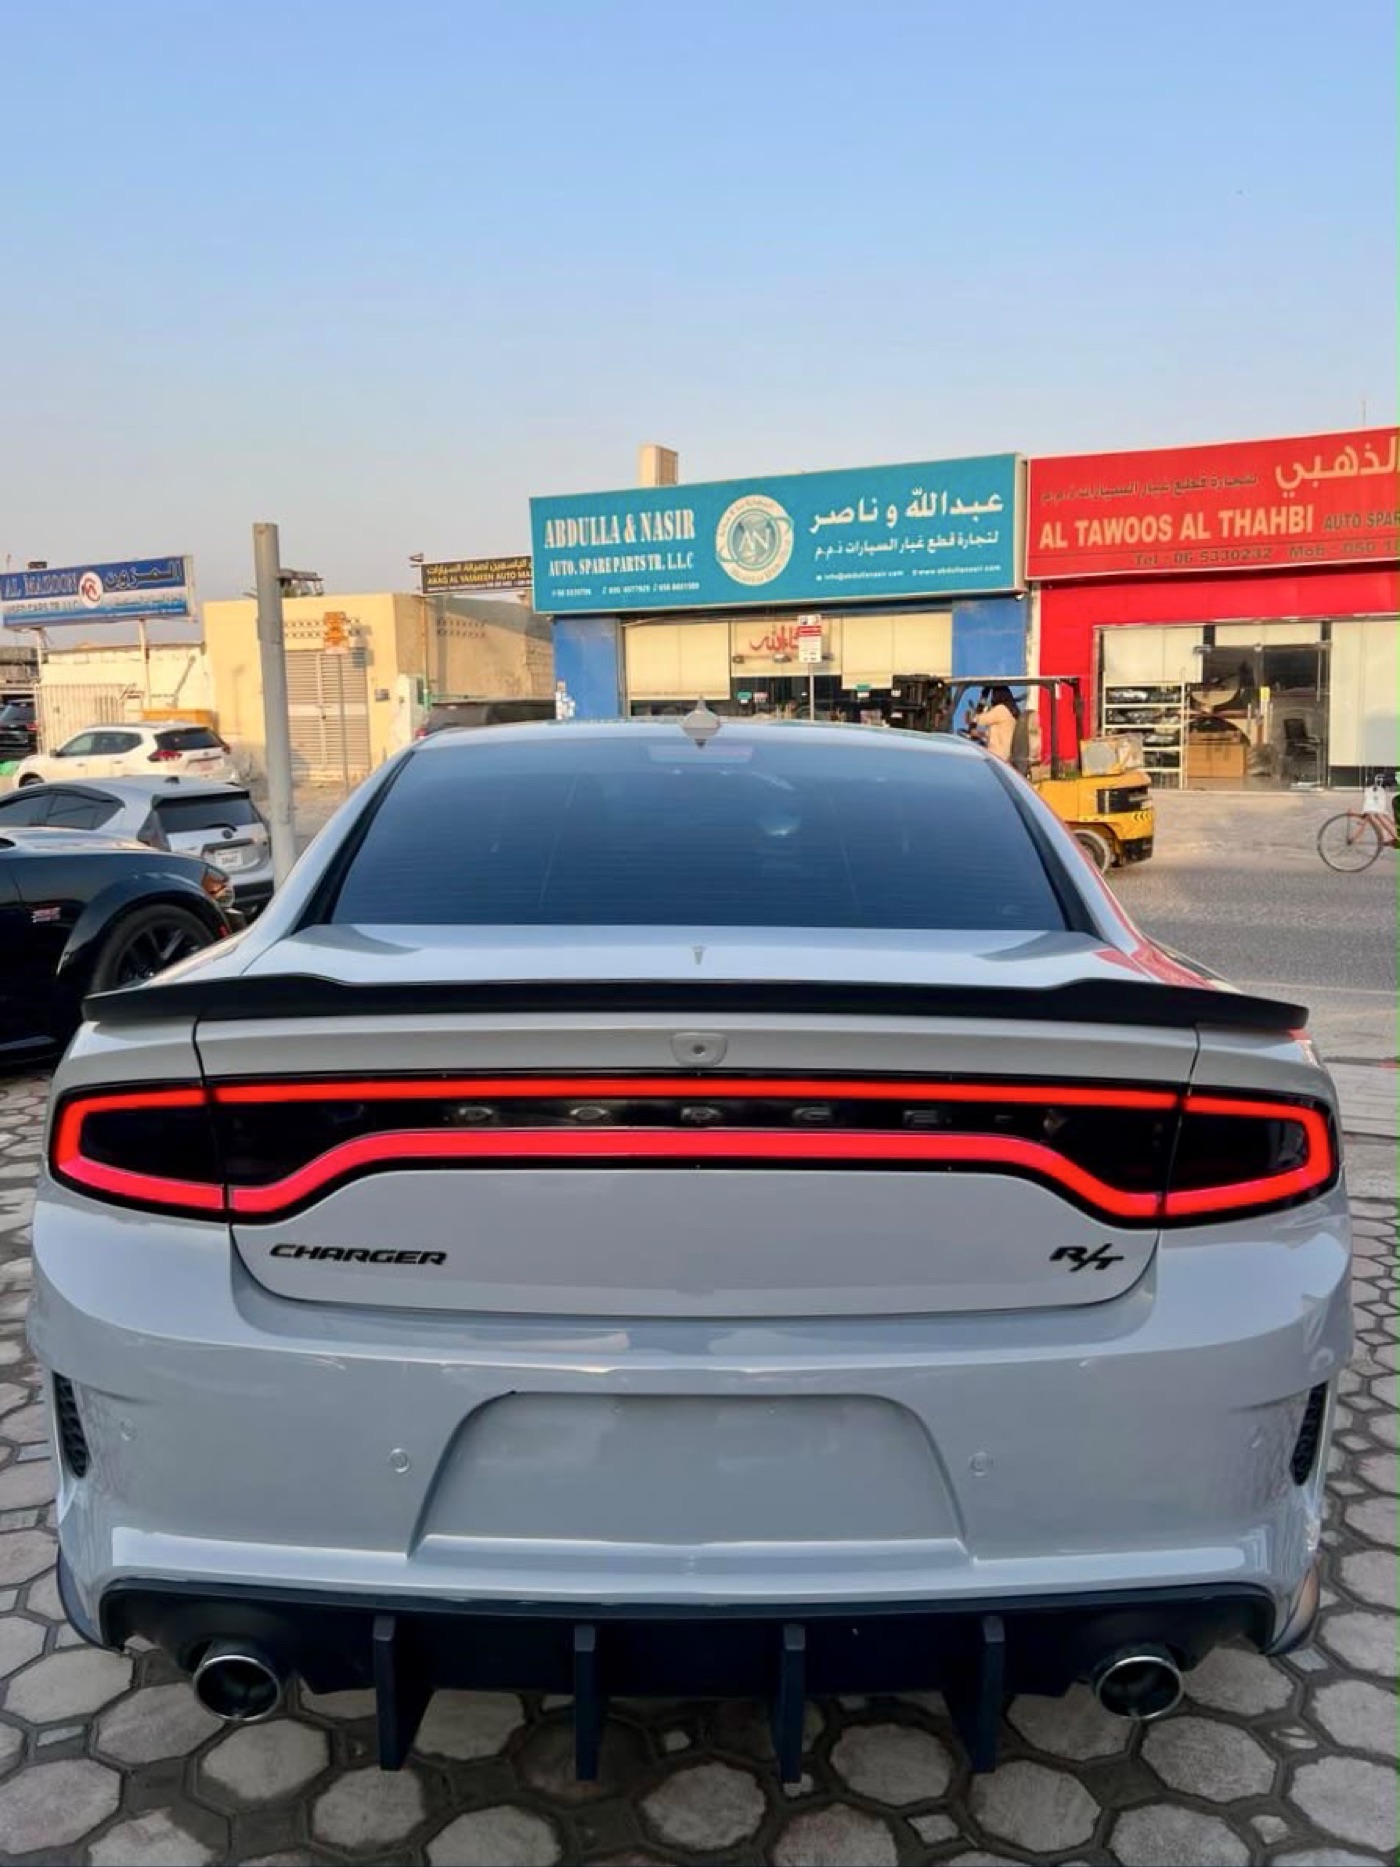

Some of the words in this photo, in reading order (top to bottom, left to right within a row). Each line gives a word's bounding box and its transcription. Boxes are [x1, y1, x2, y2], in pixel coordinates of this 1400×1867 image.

[809, 496, 878, 534] ناصر
[886, 503, 899, 529] و
[1039, 521, 1068, 549] AL
[1075, 514, 1173, 547] TAWOOS
[1180, 511, 1212, 540] AL
[1217, 503, 1315, 538] THAHBI
[1324, 512, 1361, 531] AUTO
[544, 515, 621, 549] ABDULLA
[624, 513, 637, 543] &
[639, 508, 695, 542] NASIR
[845, 538, 898, 557] السيارات
[899, 535, 925, 553] غيار
[927, 532, 956, 553] قطع
[956, 531, 1000, 550] لتجارة
[579, 557, 612, 575] SPARE
[613, 555, 646, 573] PARTS
[270, 1243, 448, 1265] CHARGER
[1049, 1243, 1124, 1272] R/T
